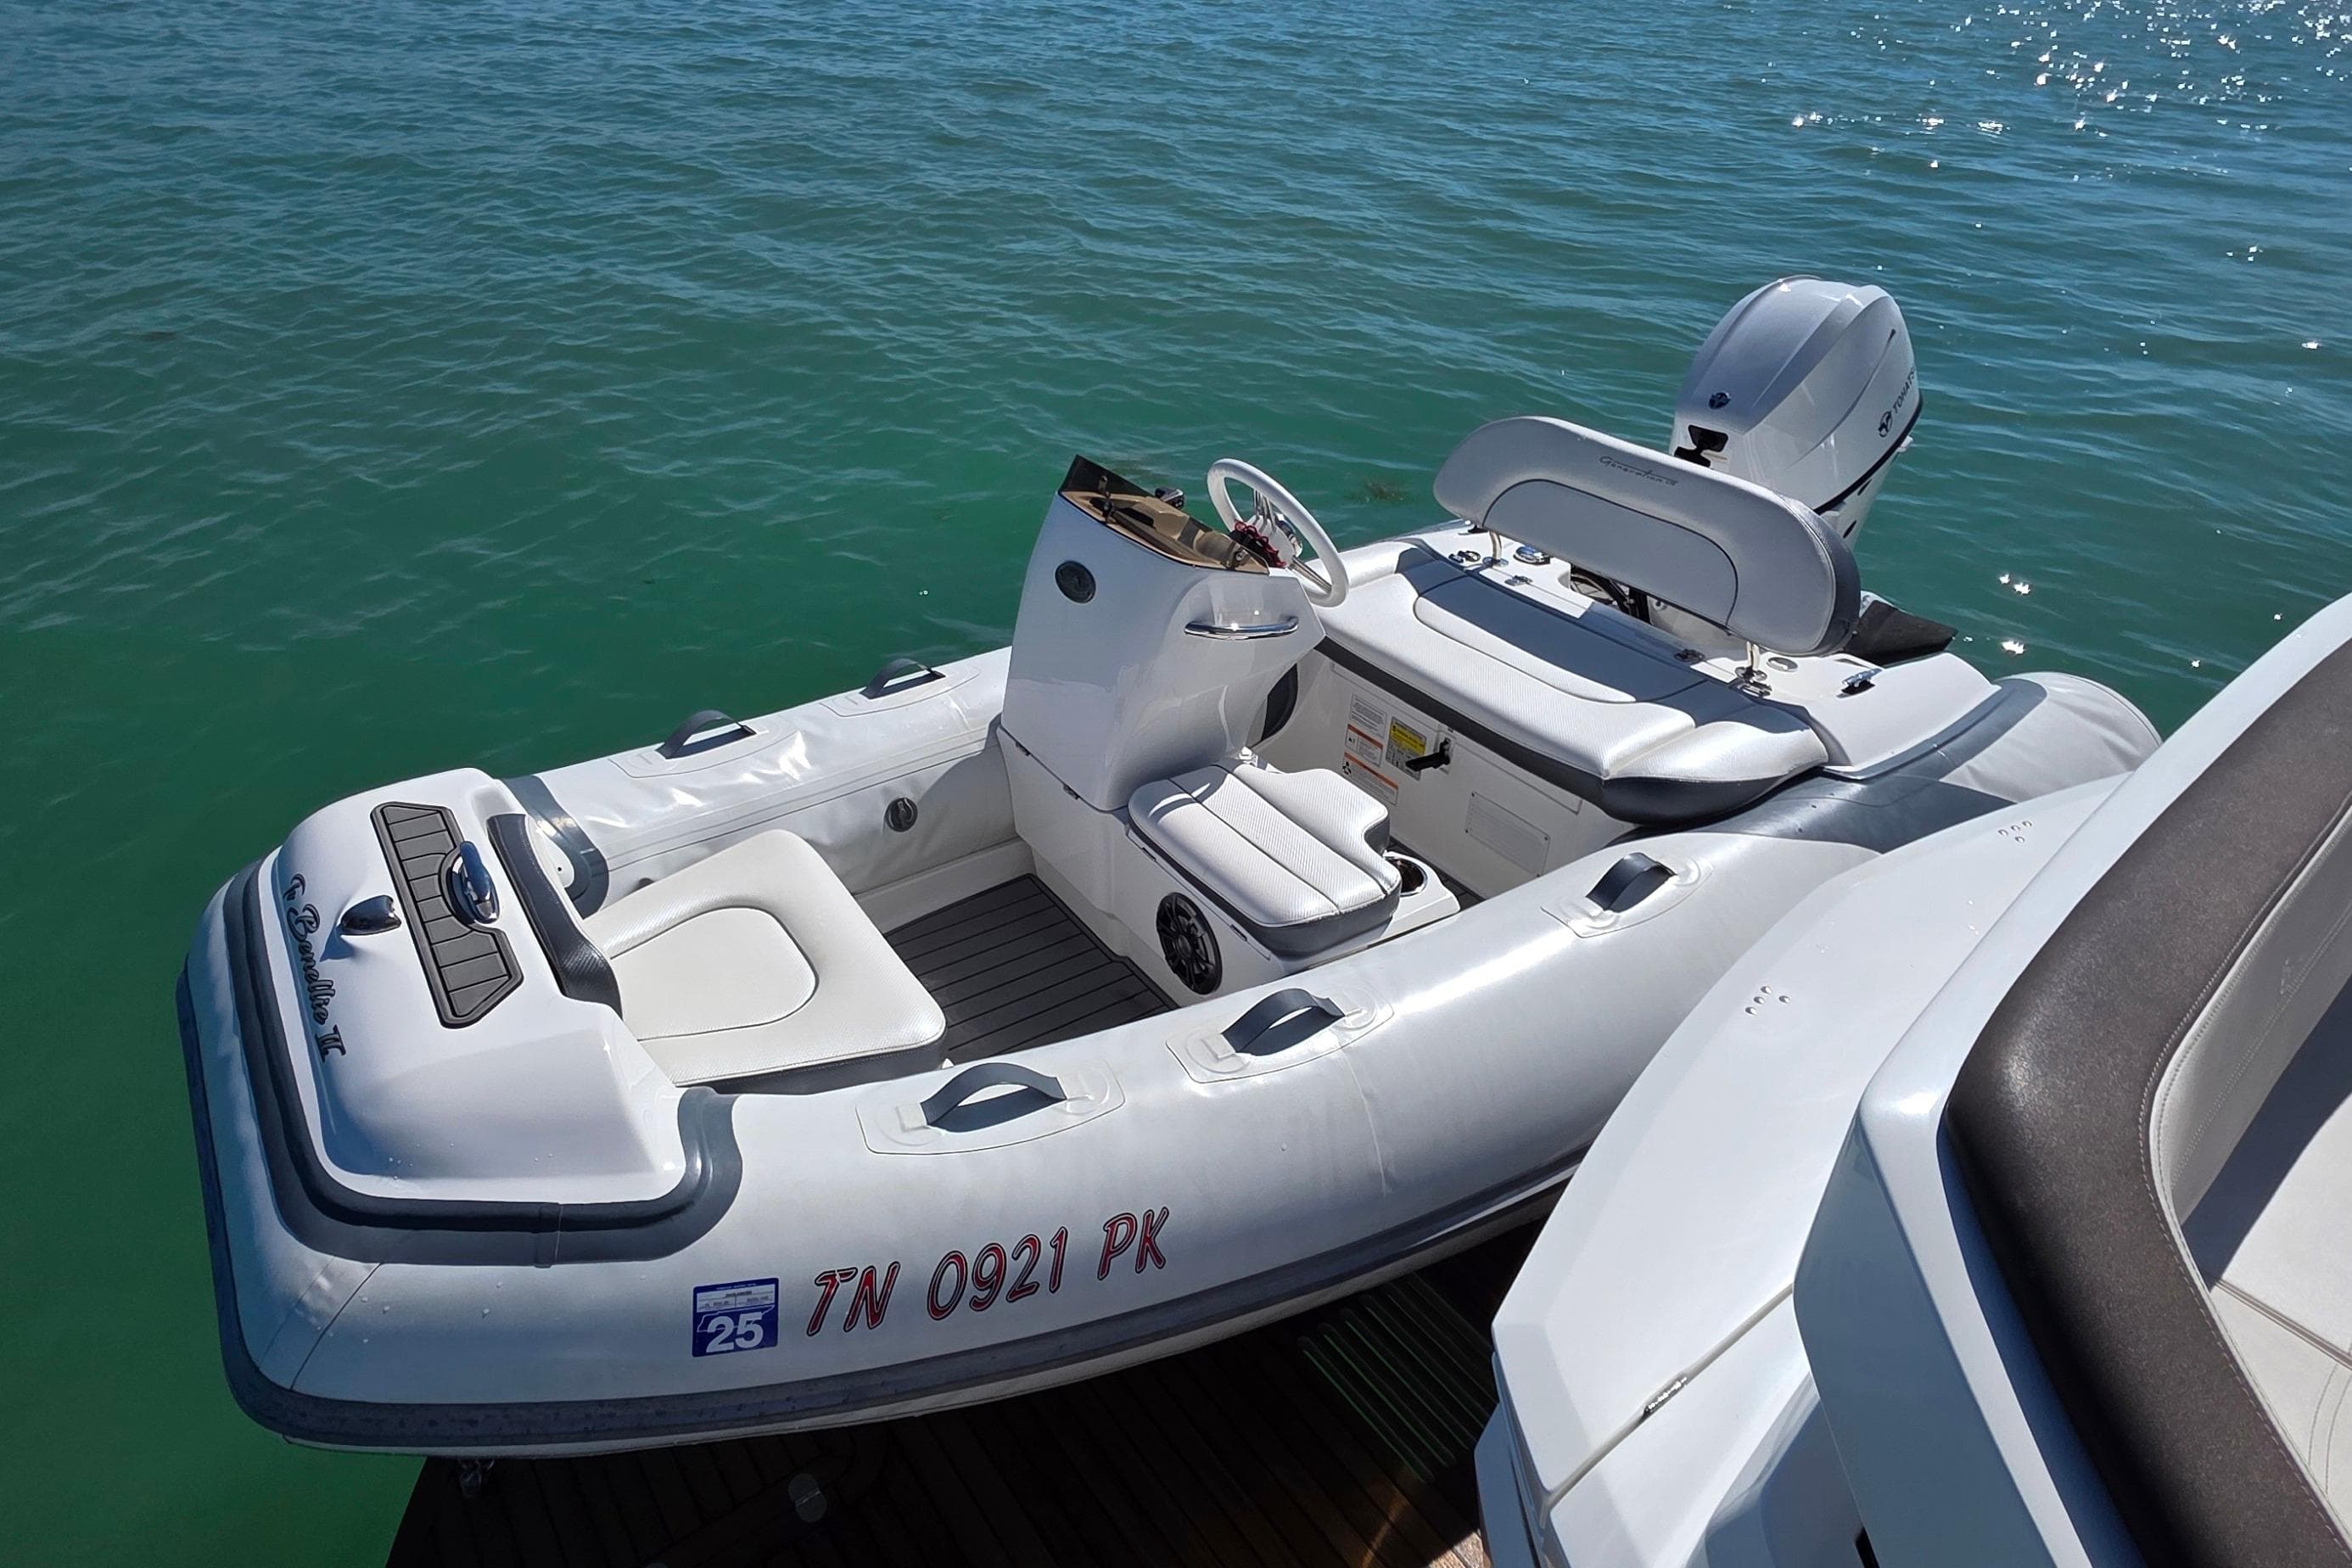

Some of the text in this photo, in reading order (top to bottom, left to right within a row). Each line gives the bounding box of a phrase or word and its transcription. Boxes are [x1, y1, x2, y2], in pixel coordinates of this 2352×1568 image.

[806, 1207, 1169, 1336] TN 0921 PK
[706, 1312, 764, 1354] 25
